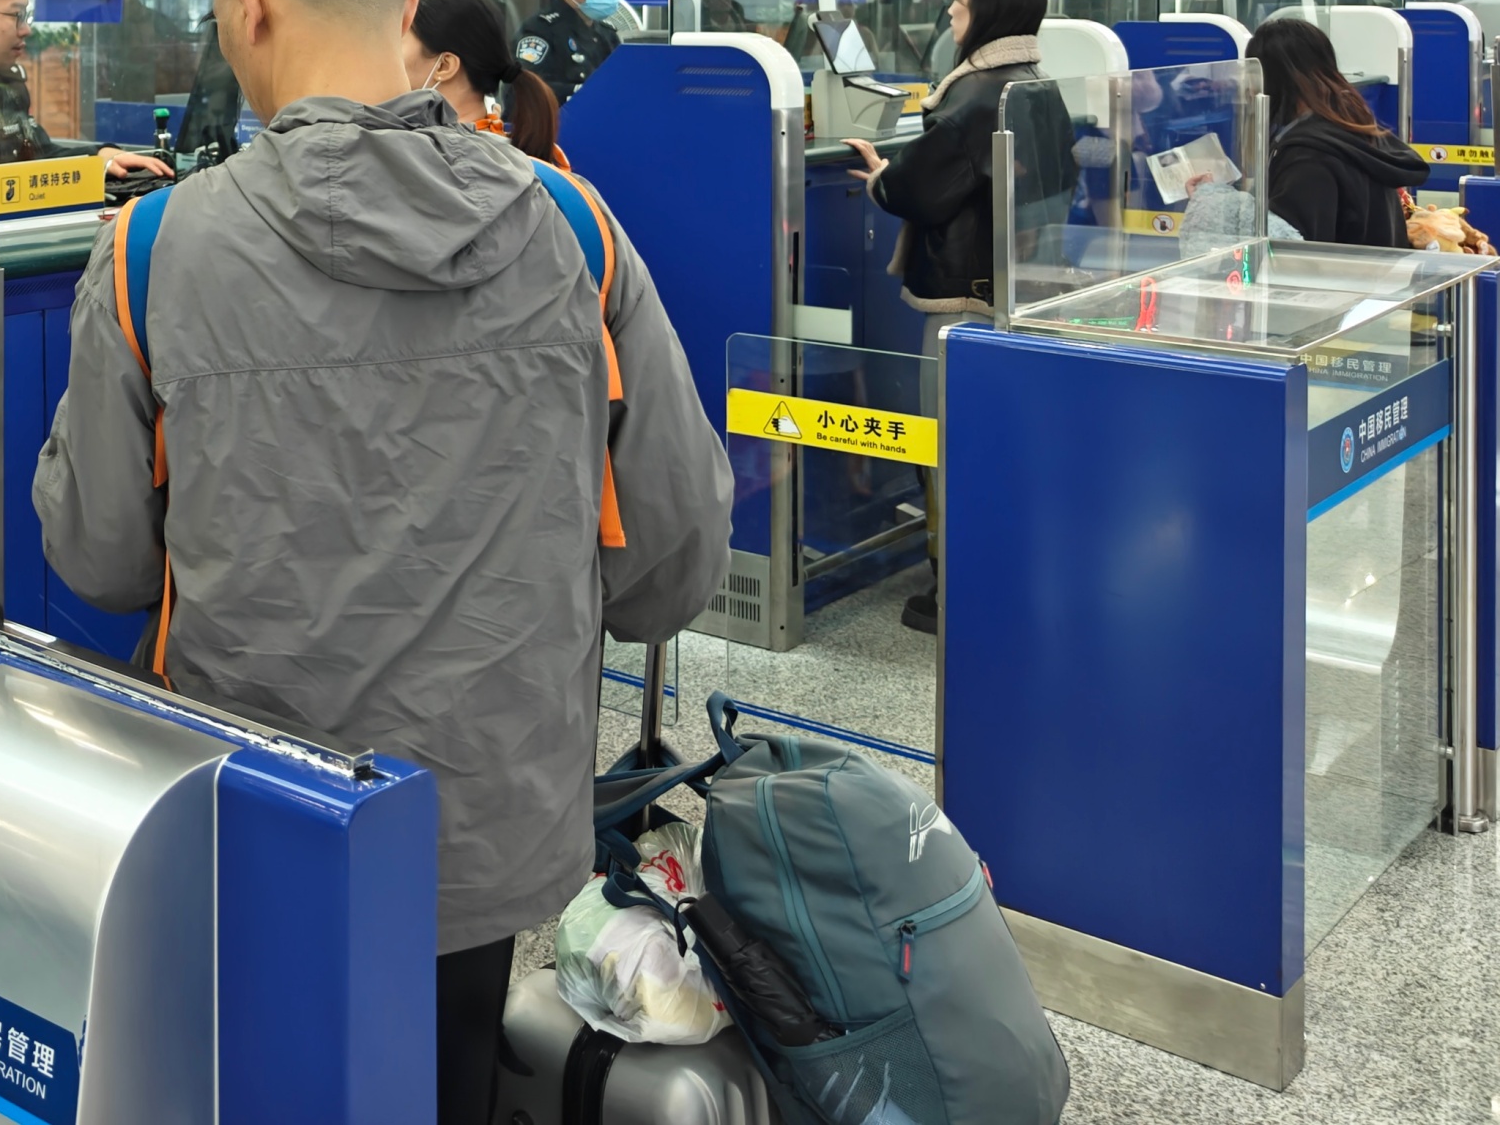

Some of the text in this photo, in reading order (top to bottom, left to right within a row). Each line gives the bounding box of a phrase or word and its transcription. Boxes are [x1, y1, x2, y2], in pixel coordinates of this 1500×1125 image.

[28, 170, 81, 189] 请保持安静
[29, 191, 45, 201] Quiet
[1299, 352, 1393, 375] 中国移民管理
[1308, 367, 1329, 376] HINA
[816, 410, 907, 441] 小心夹手
[1358, 395, 1410, 445] 中国移民管理
[816, 432, 907, 455] Be careful with hands
[1360, 426, 1408, 464] CHINA IMMIGRATION
